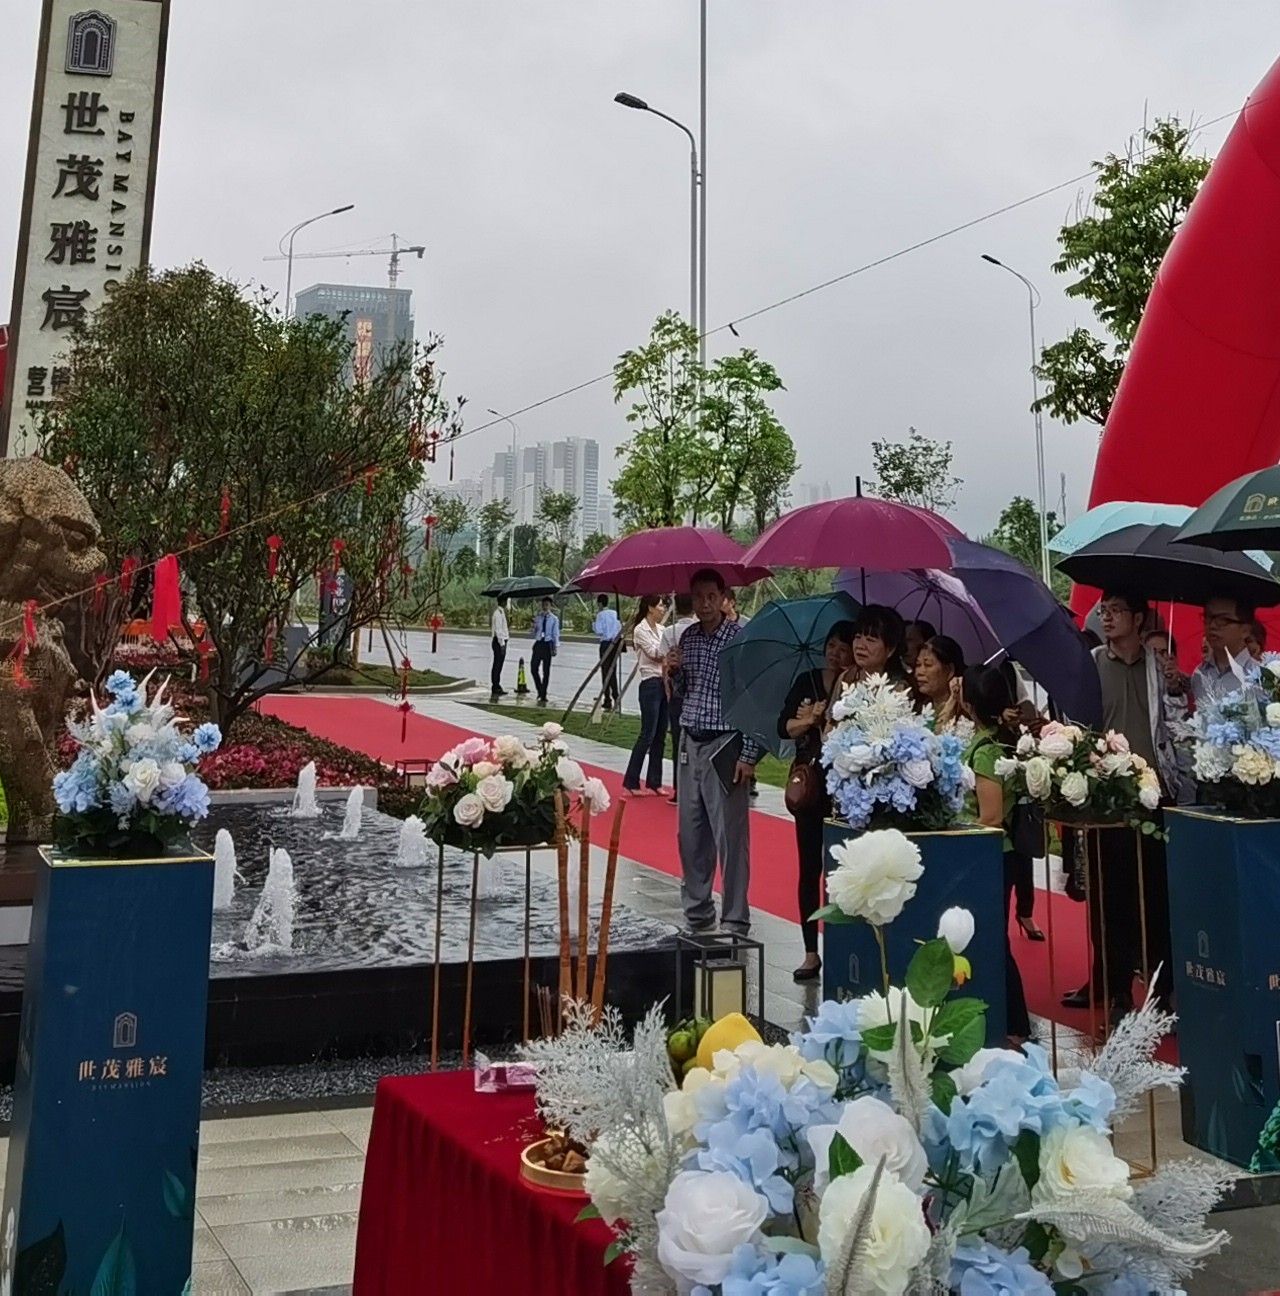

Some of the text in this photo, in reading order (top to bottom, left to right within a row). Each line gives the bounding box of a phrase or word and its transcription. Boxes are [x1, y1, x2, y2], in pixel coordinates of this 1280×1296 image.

[39, 91, 110, 331] 世茂雅宸
[79, 1055, 168, 1082] 世茂雅宸
